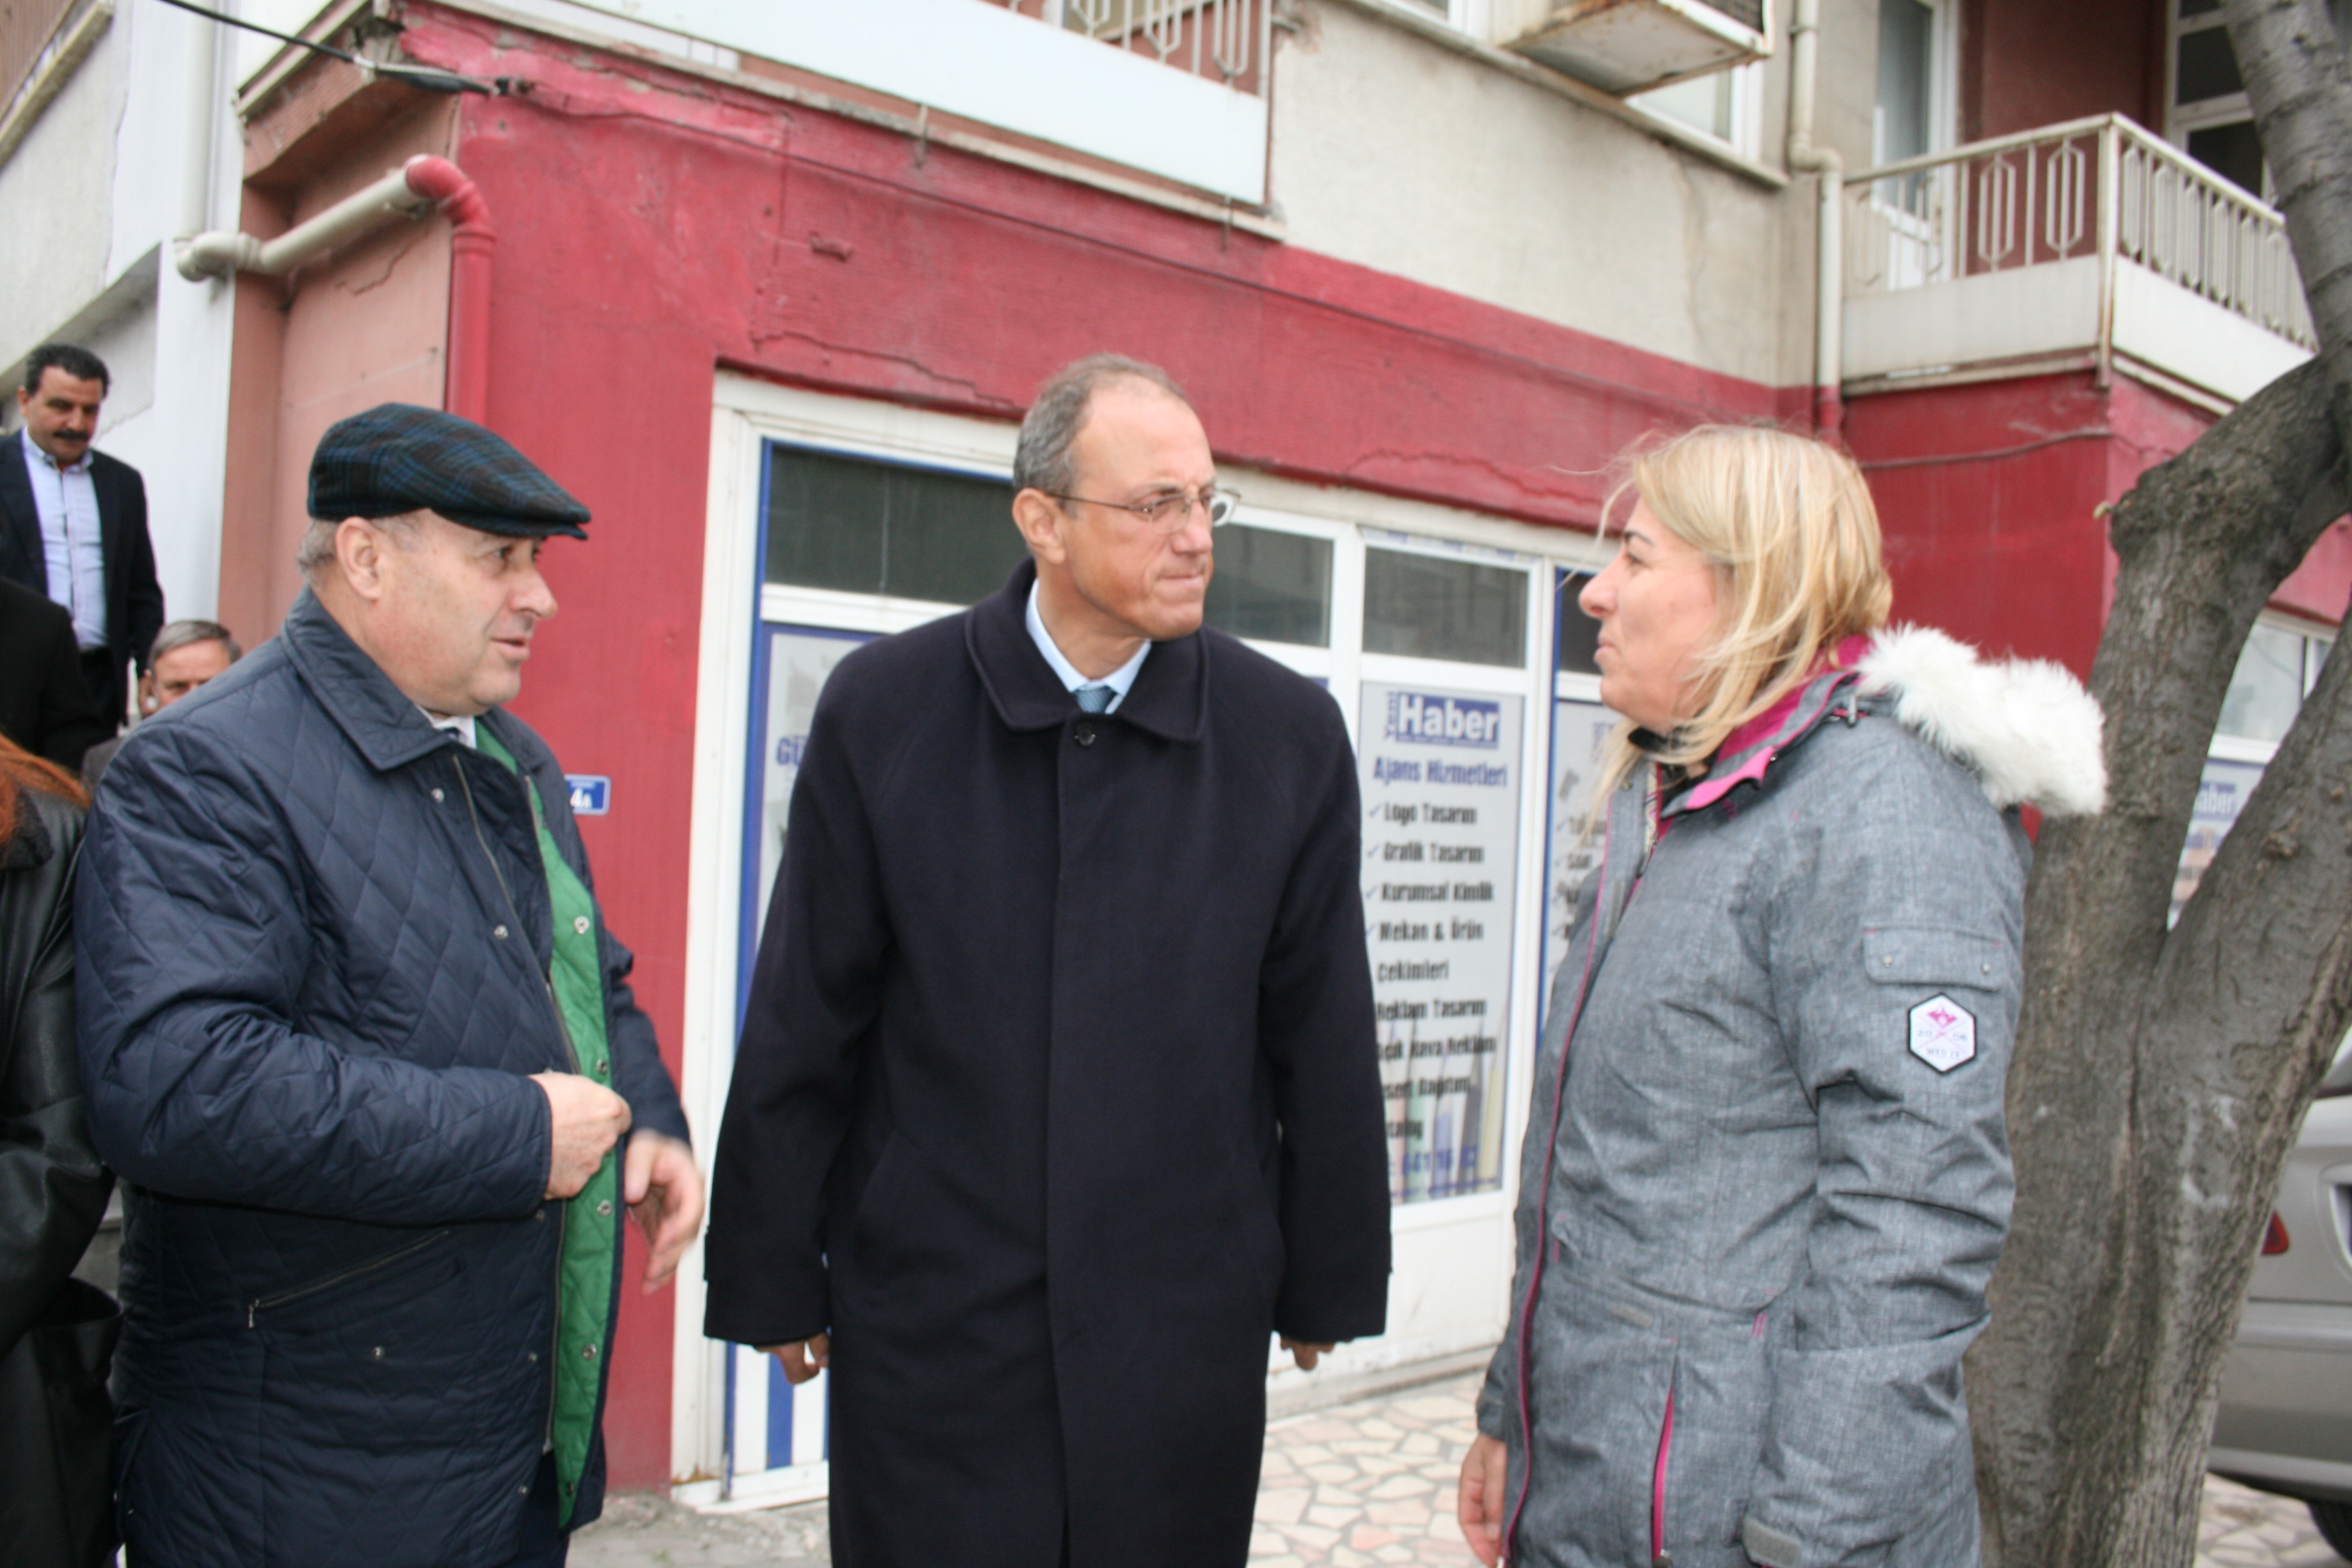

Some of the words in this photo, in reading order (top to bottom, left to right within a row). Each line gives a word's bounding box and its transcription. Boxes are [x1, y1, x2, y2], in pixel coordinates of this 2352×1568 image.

[1399, 694, 1498, 740] Haber
[1374, 756, 1420, 785] Ajans
[1427, 759, 1508, 788] Hizmetleri
[2196, 785, 2234, 814] aber
[1385, 801, 1417, 826] Logo
[1384, 841, 1423, 861] Grafik
[1382, 881, 1449, 901] Kurumsal
[1454, 881, 1493, 901] Kimlik
[1379, 921, 1428, 941] Mekan
[1434, 923, 1444, 941] &
[1451, 916, 1484, 939] Ürün
[1377, 961, 1449, 984] Çekimleri
